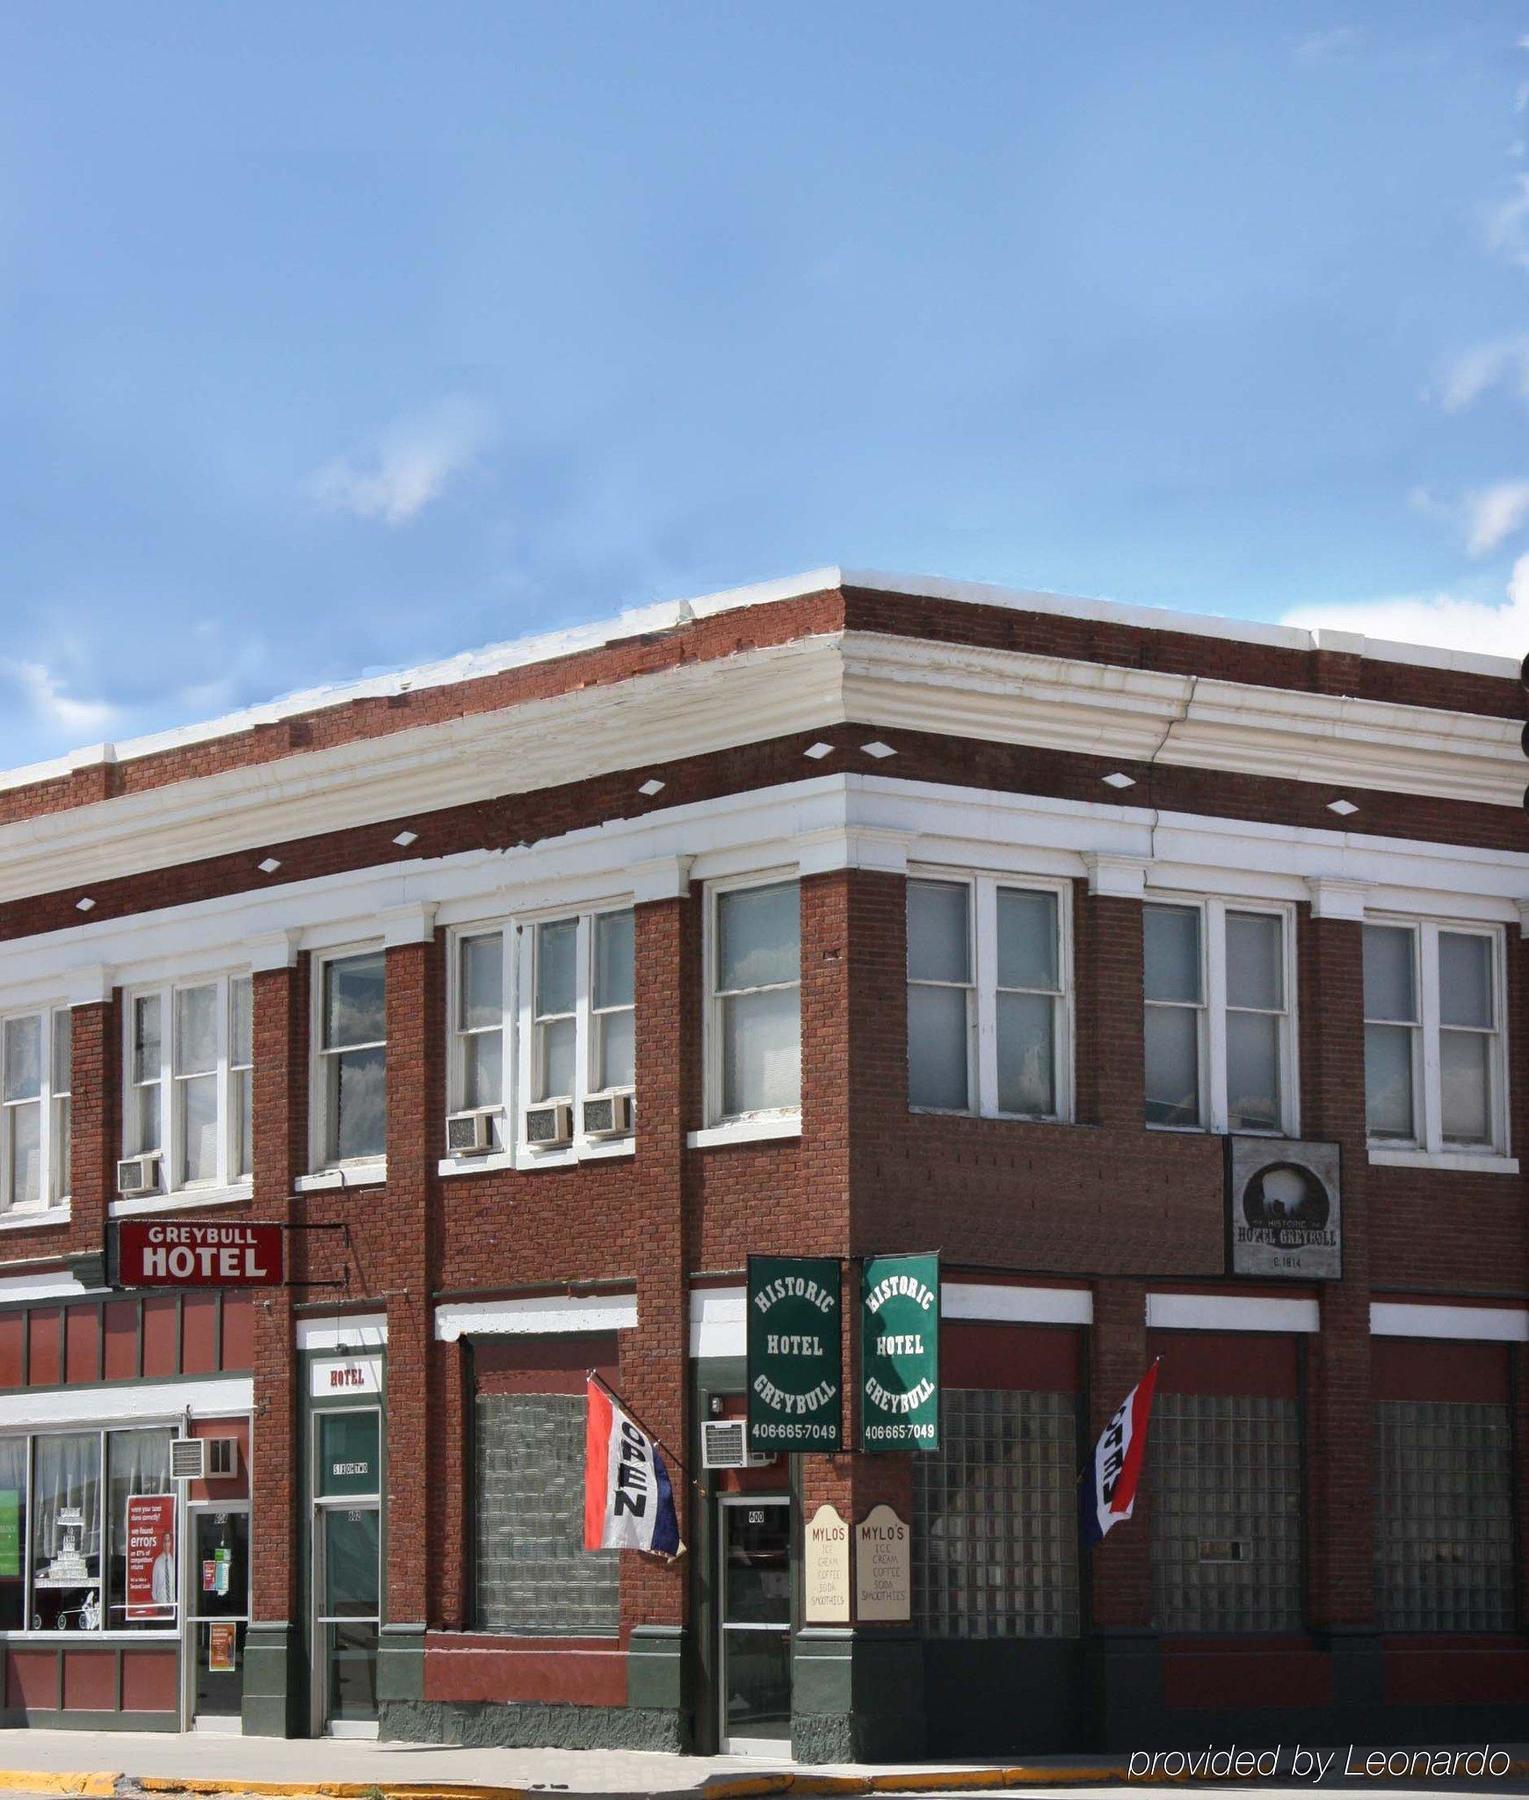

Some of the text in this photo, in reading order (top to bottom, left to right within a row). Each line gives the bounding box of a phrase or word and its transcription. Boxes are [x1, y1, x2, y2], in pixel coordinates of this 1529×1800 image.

[148, 1226, 258, 1244] GREYBULL
[1238, 1227, 1337, 1247] HOTEL GREYBULL
[143, 1246, 267, 1278] HOTEL
[754, 1276, 835, 1313] HISTORIC
[865, 1275, 935, 1314] HISTORIC
[767, 1335, 823, 1356] HOTEL
[876, 1335, 924, 1356] HOTEL
[330, 1368, 365, 1387] HOTEL
[753, 1374, 836, 1415] GREYBULL
[865, 1377, 935, 1414] GREYBULL
[752, 1424, 836, 1439] 406-665-7049
[865, 1424, 935, 1439] 406-665-7049
[614, 1421, 647, 1518] OPEN
[749, 1511, 764, 1523] 600
[812, 1525, 845, 1541] MYLO'S
[862, 1524, 904, 1540] MYLO'S
[130, 1536, 157, 1547] errors
[822, 1544, 833, 1554] ICE
[875, 1543, 892, 1553] ICE
[873, 1555, 898, 1564] CREAM
[818, 1569, 840, 1579] COFFEE
[873, 1567, 900, 1577] COFFEE
[819, 1583, 836, 1593] SODA
[862, 1590, 905, 1601] SMOOTHIES
